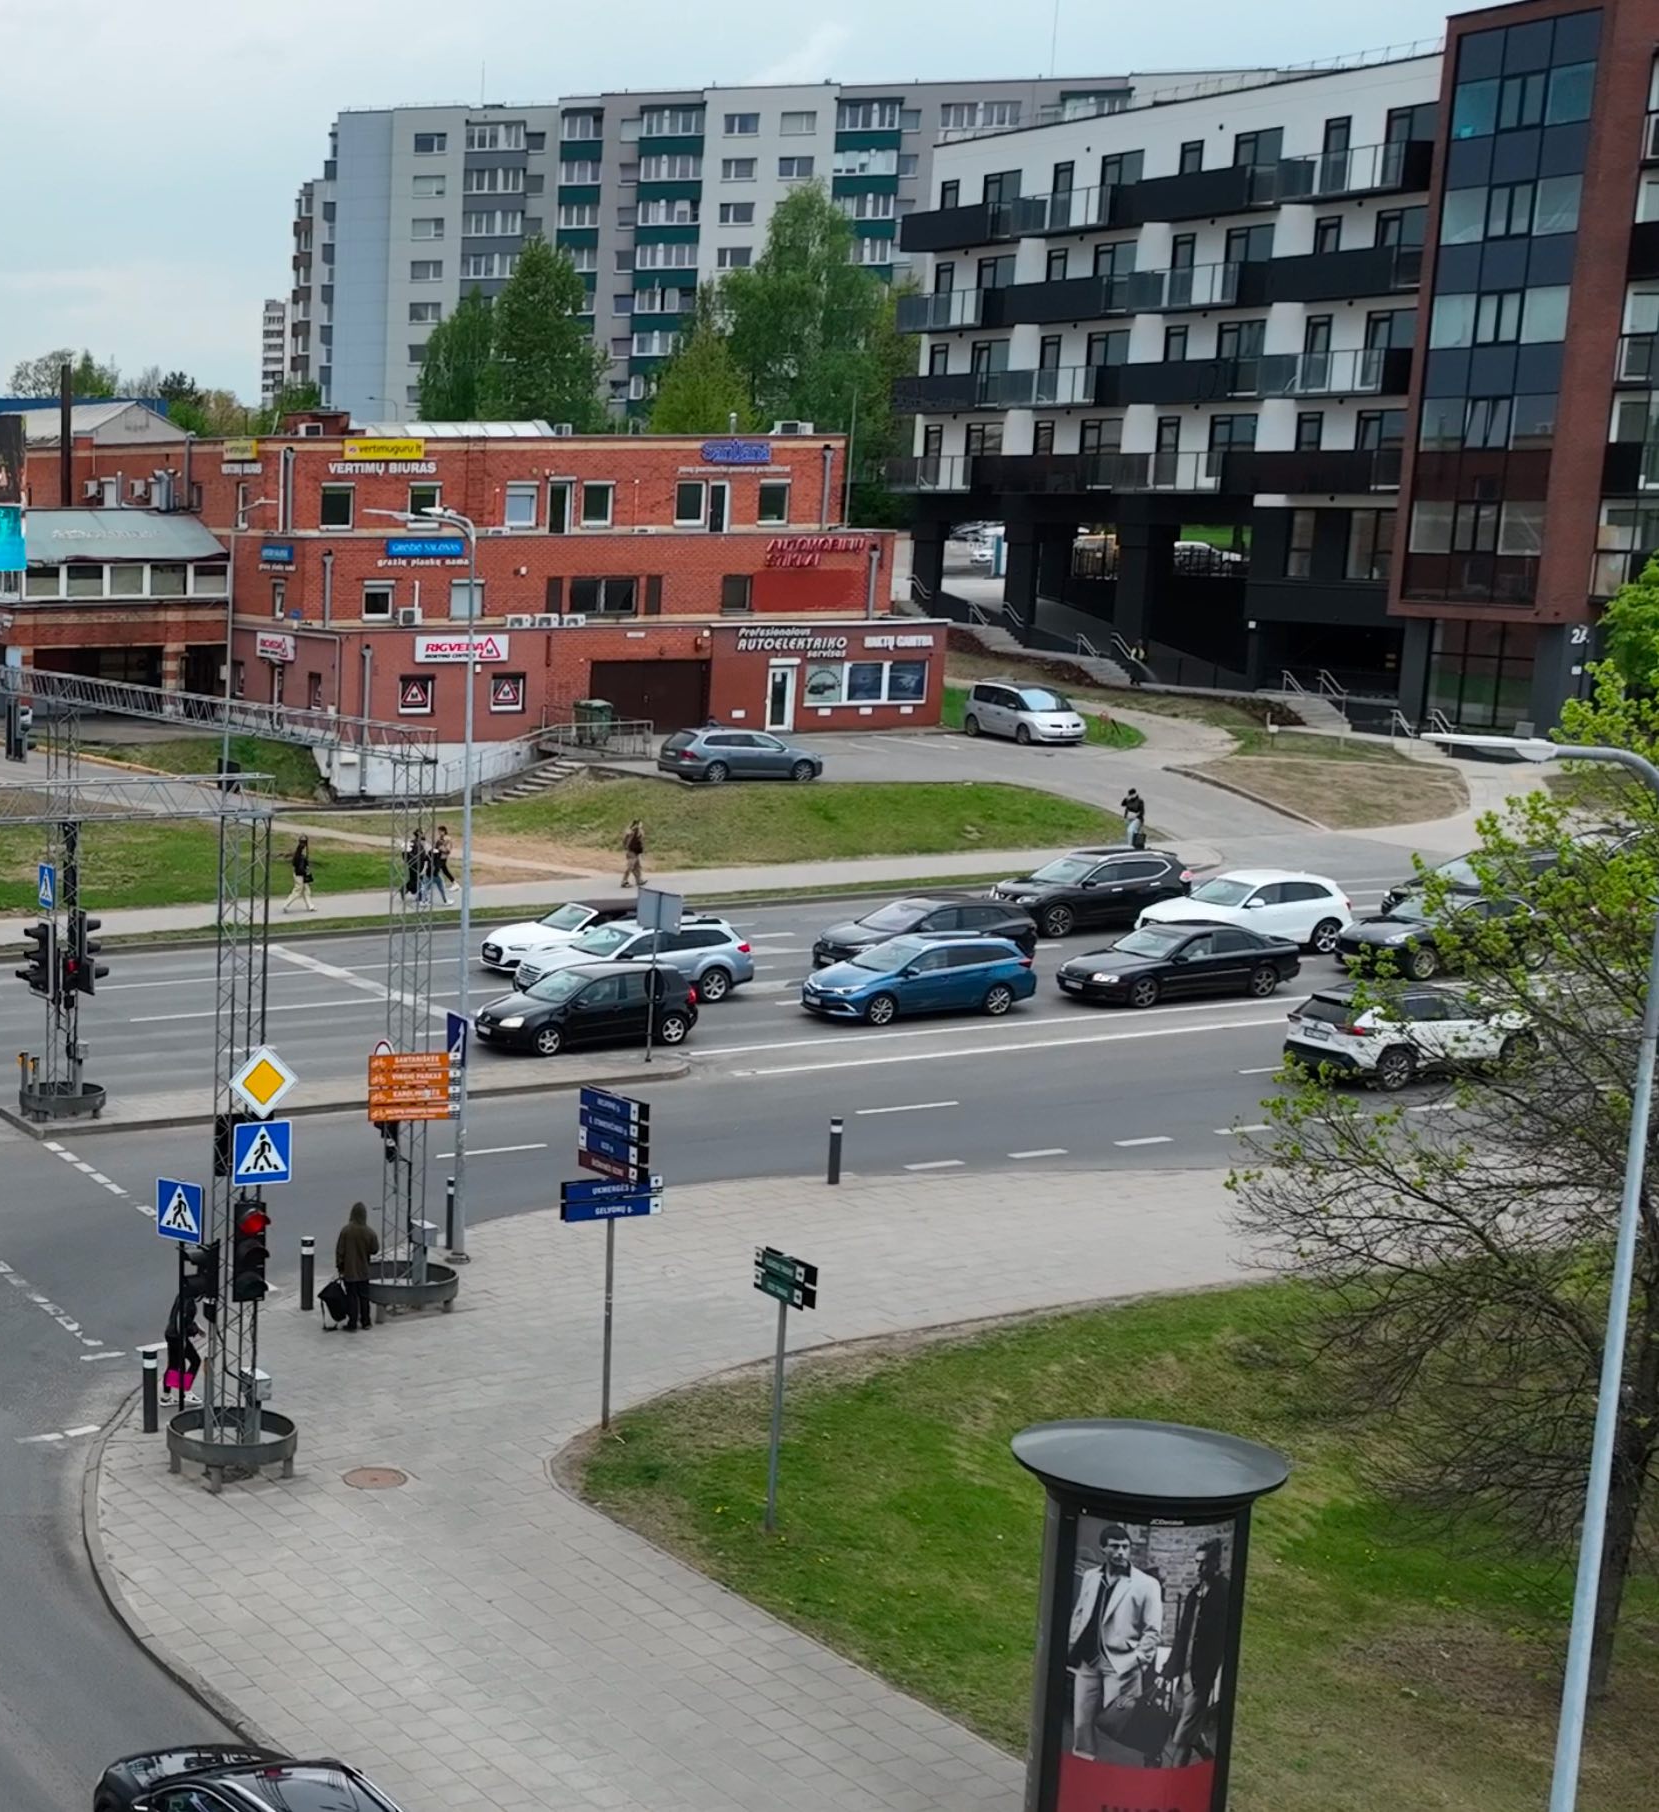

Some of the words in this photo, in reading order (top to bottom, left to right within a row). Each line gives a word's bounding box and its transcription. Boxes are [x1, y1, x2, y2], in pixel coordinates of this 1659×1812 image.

[328, 462, 385, 476] VERTIMŲ
[388, 461, 438, 474] BIURAS
[737, 636, 848, 651] AUTOELEKTRIKO
